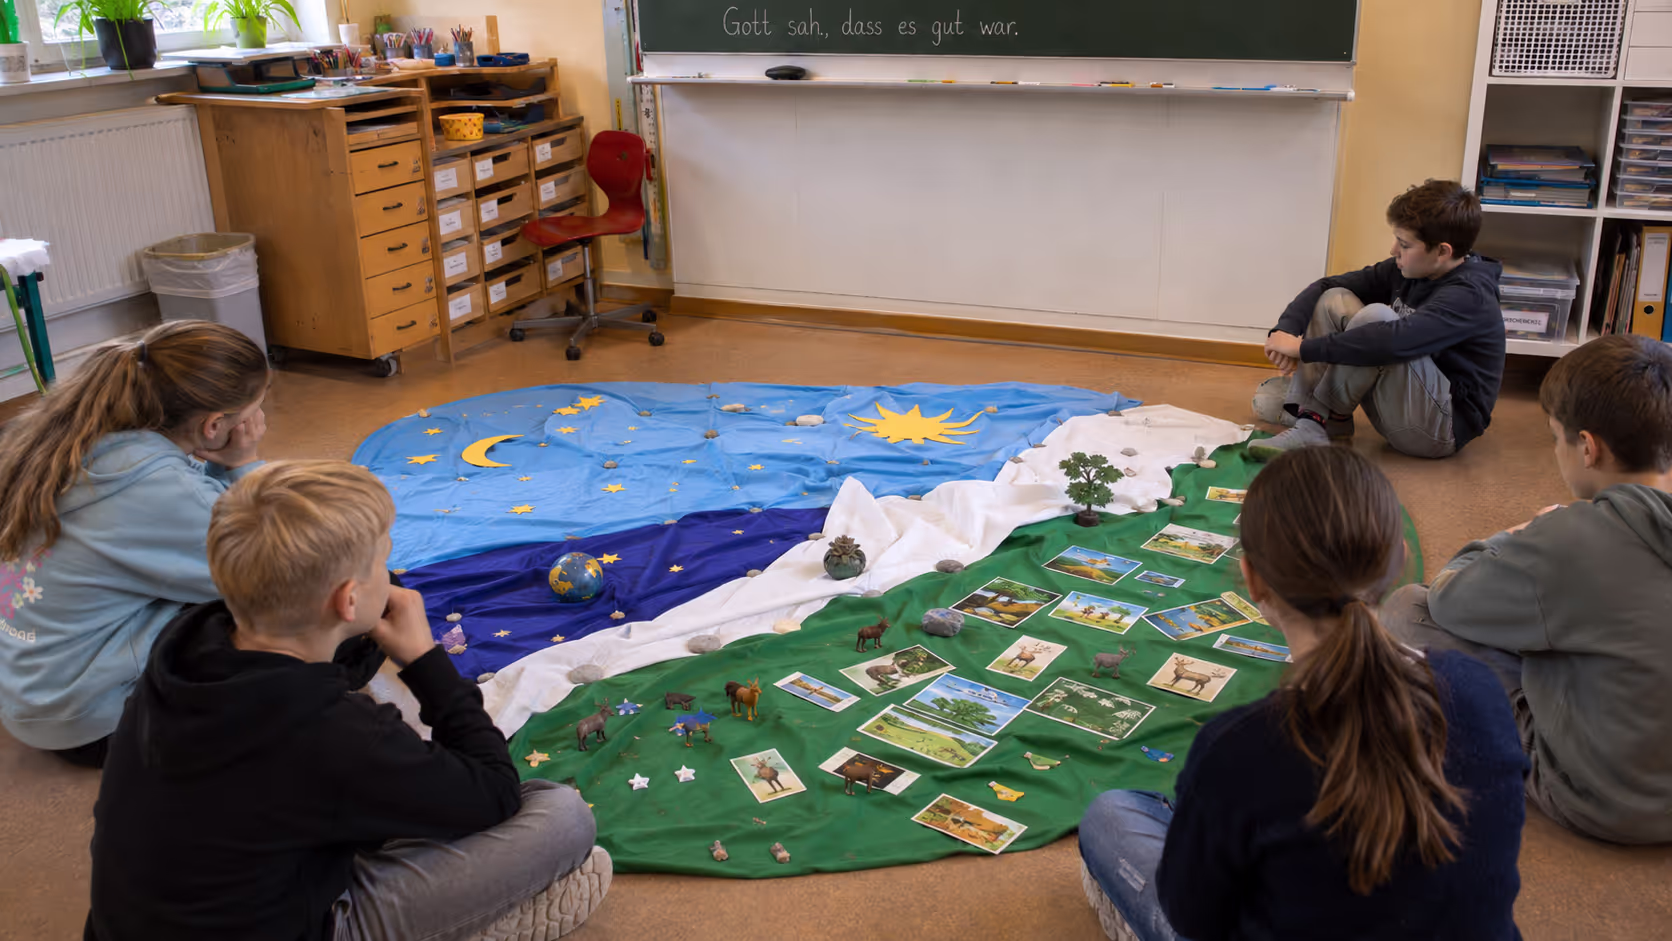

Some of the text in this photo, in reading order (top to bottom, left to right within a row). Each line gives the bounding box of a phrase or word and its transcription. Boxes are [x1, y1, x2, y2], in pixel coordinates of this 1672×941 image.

[723, 6, 772, 36] Gott
[841, 8, 882, 36] dass
[898, 20, 917, 35] es
[931, 9, 964, 46] gut
[979, 20, 1018, 36] war.
